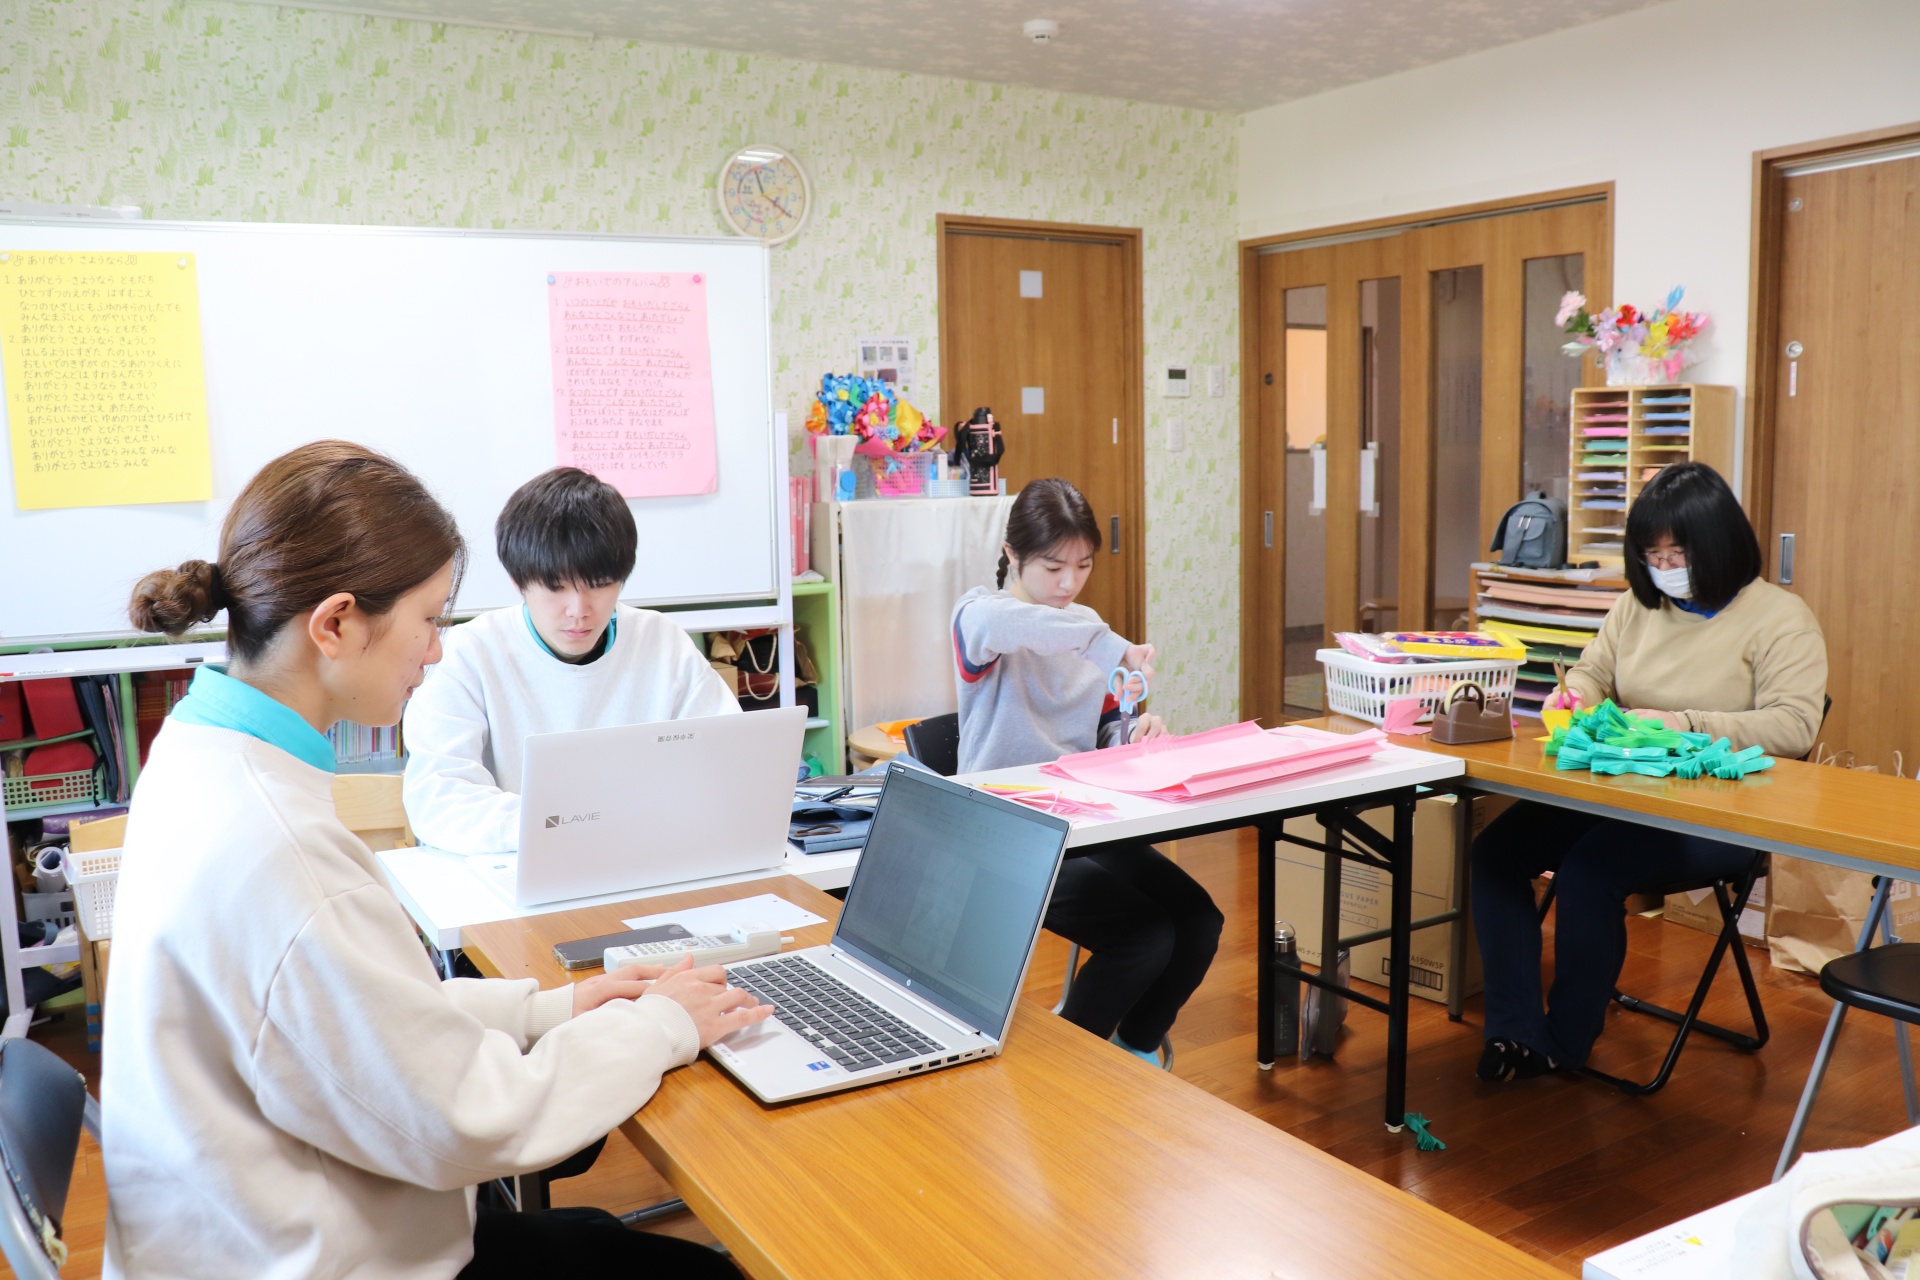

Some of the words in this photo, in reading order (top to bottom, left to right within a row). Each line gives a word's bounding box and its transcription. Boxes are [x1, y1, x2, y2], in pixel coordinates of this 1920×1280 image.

[791, 192, 797, 202] 3
[561, 812, 600, 825] LAVIE
[1340, 890, 1354, 899] SUE
[1356, 894, 1379, 906] PAPER
